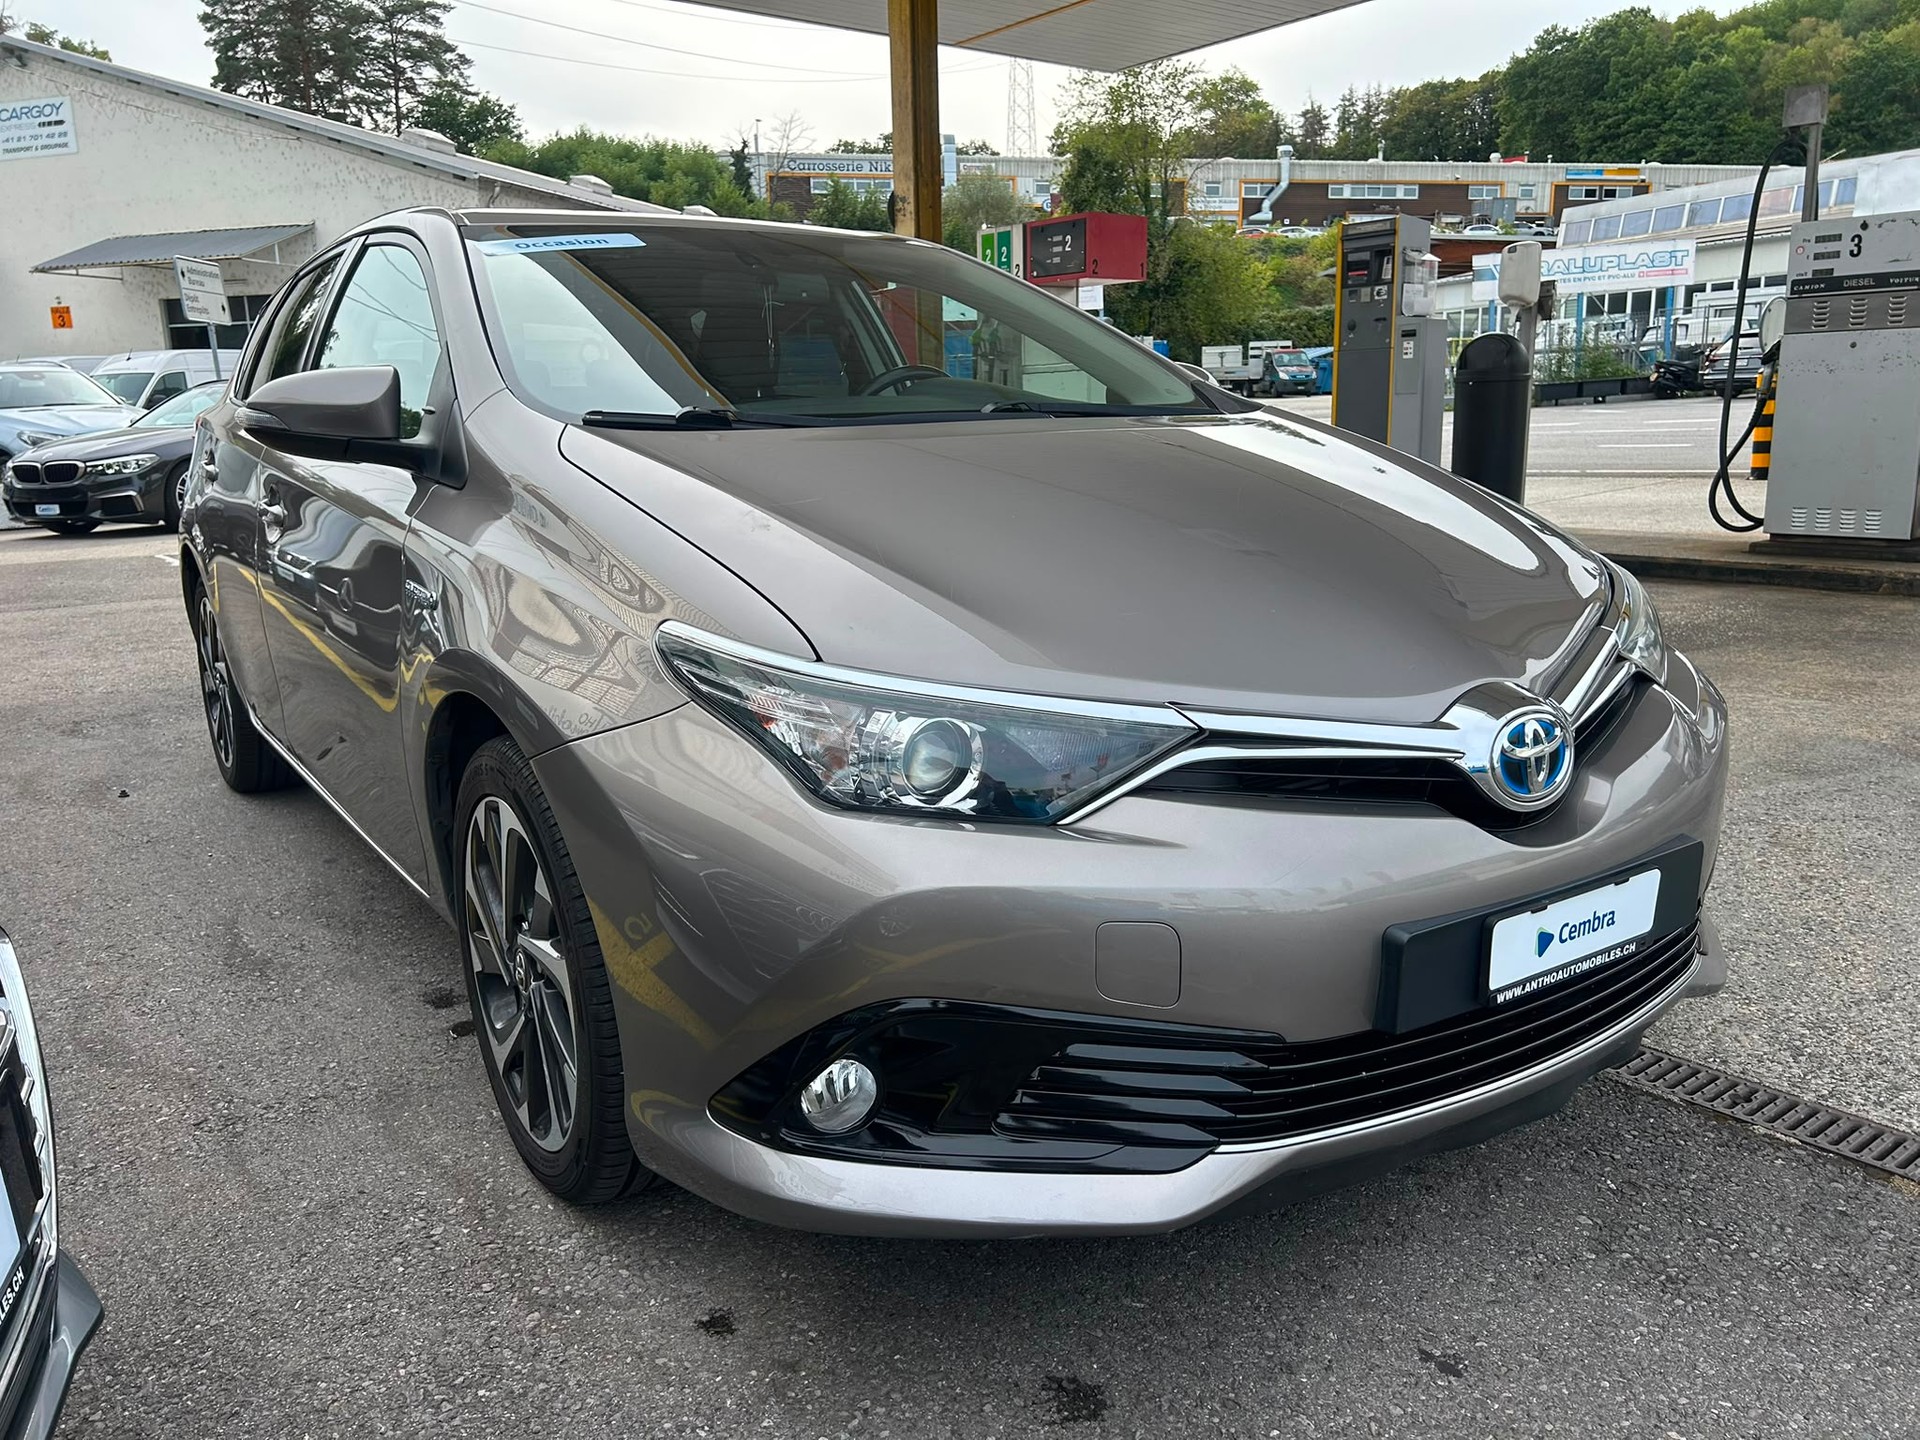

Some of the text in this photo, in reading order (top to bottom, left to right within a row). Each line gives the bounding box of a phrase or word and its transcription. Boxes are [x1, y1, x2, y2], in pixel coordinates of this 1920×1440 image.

[0, 101, 64, 122] CARGOY
[2, 146, 33, 154] TRANSPORT
[787, 160, 864, 172] Carrosserie
[514, 238, 609, 249] Occasion
[1064, 234, 1072, 251] 2
[1849, 233, 1863, 258] 3
[985, 249, 992, 264] 2
[1001, 246, 1008, 262] 2
[1014, 263, 1021, 278] 2
[1092, 258, 1099, 275] 2
[1139, 262, 1145, 278] 1
[1583, 273, 1596, 281] PVC
[1607, 270, 1636, 280] PVC-ALU
[1793, 283, 1826, 291] CAMION
[1843, 277, 1876, 287] DIESEL
[58, 314, 66, 328] 3
[1559, 910, 1616, 944] Cembra
[1496, 942, 1637, 1004] WWW.ANTHOAUTOMOBILES.CH
